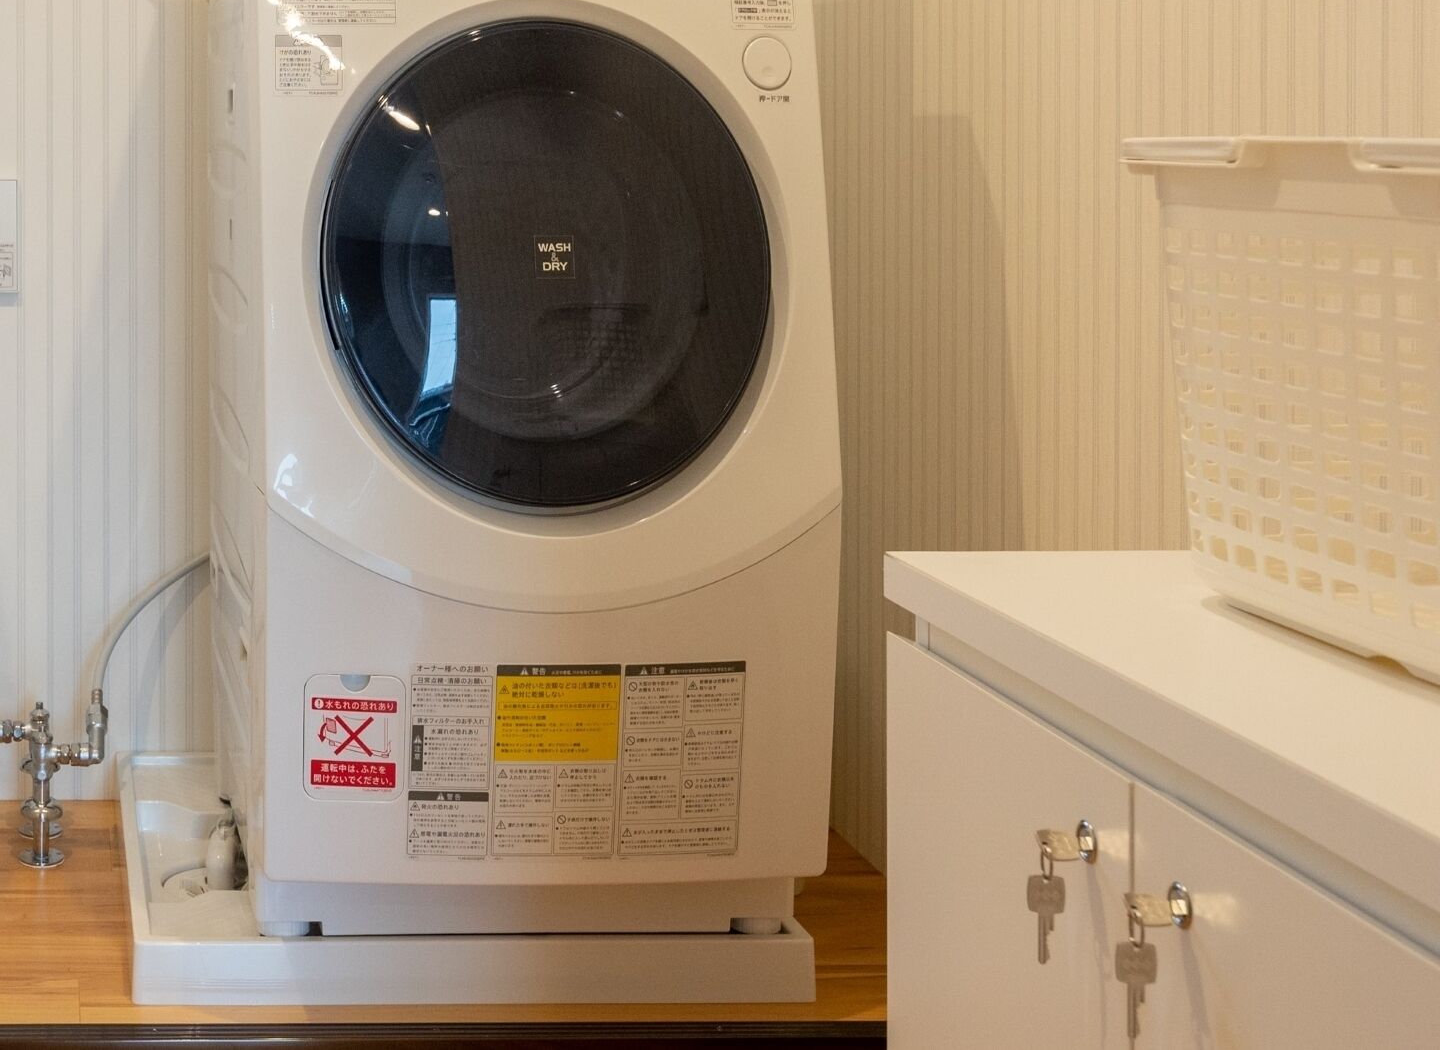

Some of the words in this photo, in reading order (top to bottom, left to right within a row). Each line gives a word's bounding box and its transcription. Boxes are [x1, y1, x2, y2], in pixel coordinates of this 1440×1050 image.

[537, 242, 571, 252] WASH
[551, 252, 560, 262] &
[542, 261, 568, 270] DRY
[325, 700, 394, 712] 水もれの恐れあり
[321, 762, 387, 774] 運転中は、ふたを
[314, 774, 393, 786] 開けないでください。
